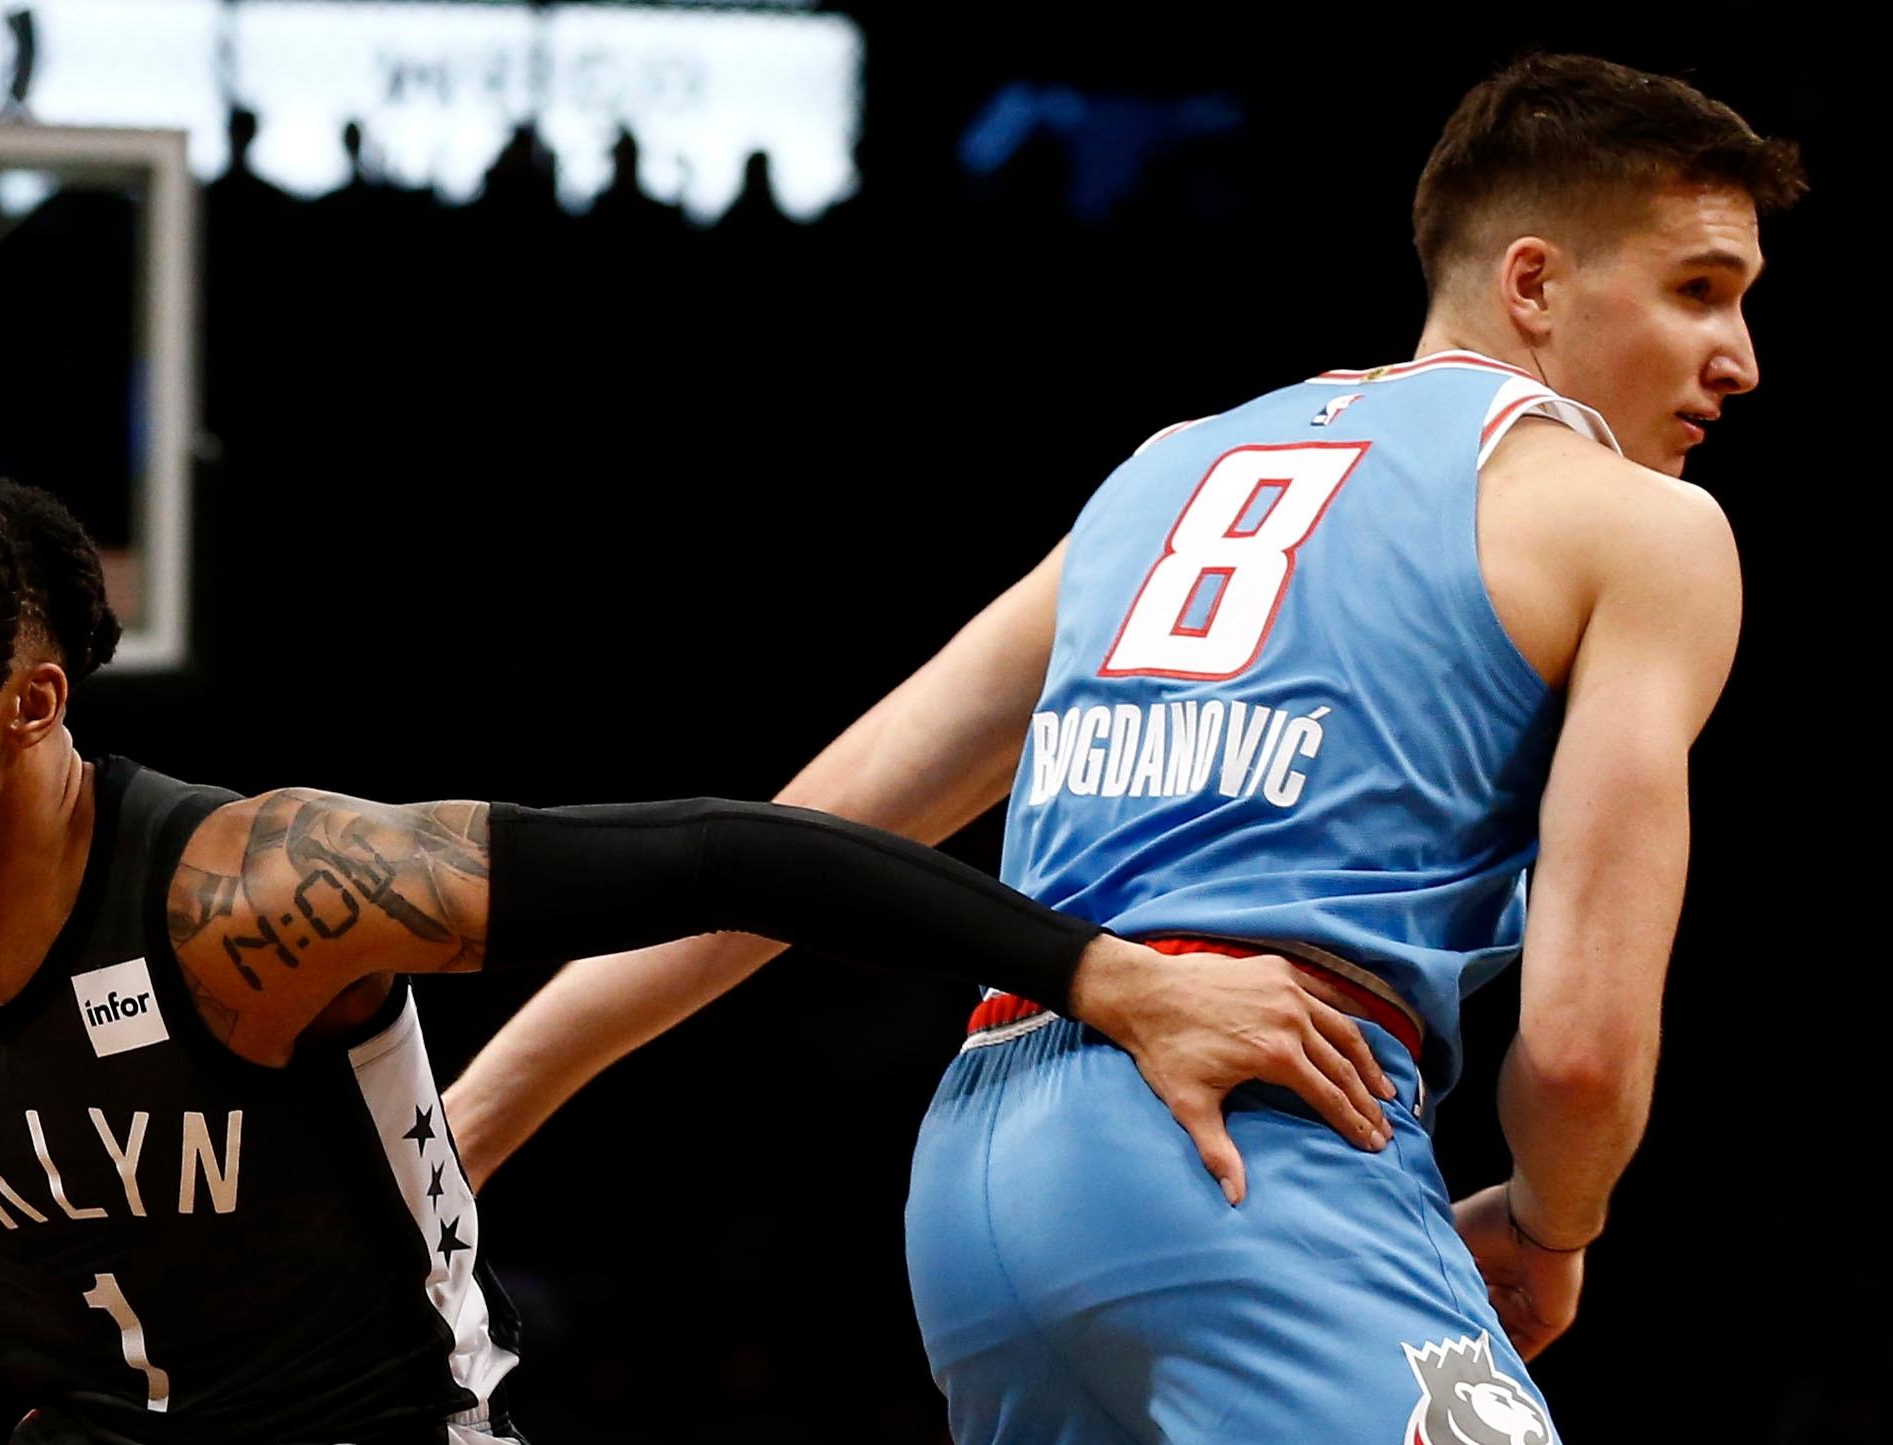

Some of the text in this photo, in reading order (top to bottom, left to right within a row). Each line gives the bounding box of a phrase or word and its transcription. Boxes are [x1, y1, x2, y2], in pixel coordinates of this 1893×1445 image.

[1097, 441, 1372, 682] 8
[1028, 699, 1332, 808] BOGDANOVIĆ
[85, 991, 150, 1027] infor
[82, 1273, 170, 1413] 1
